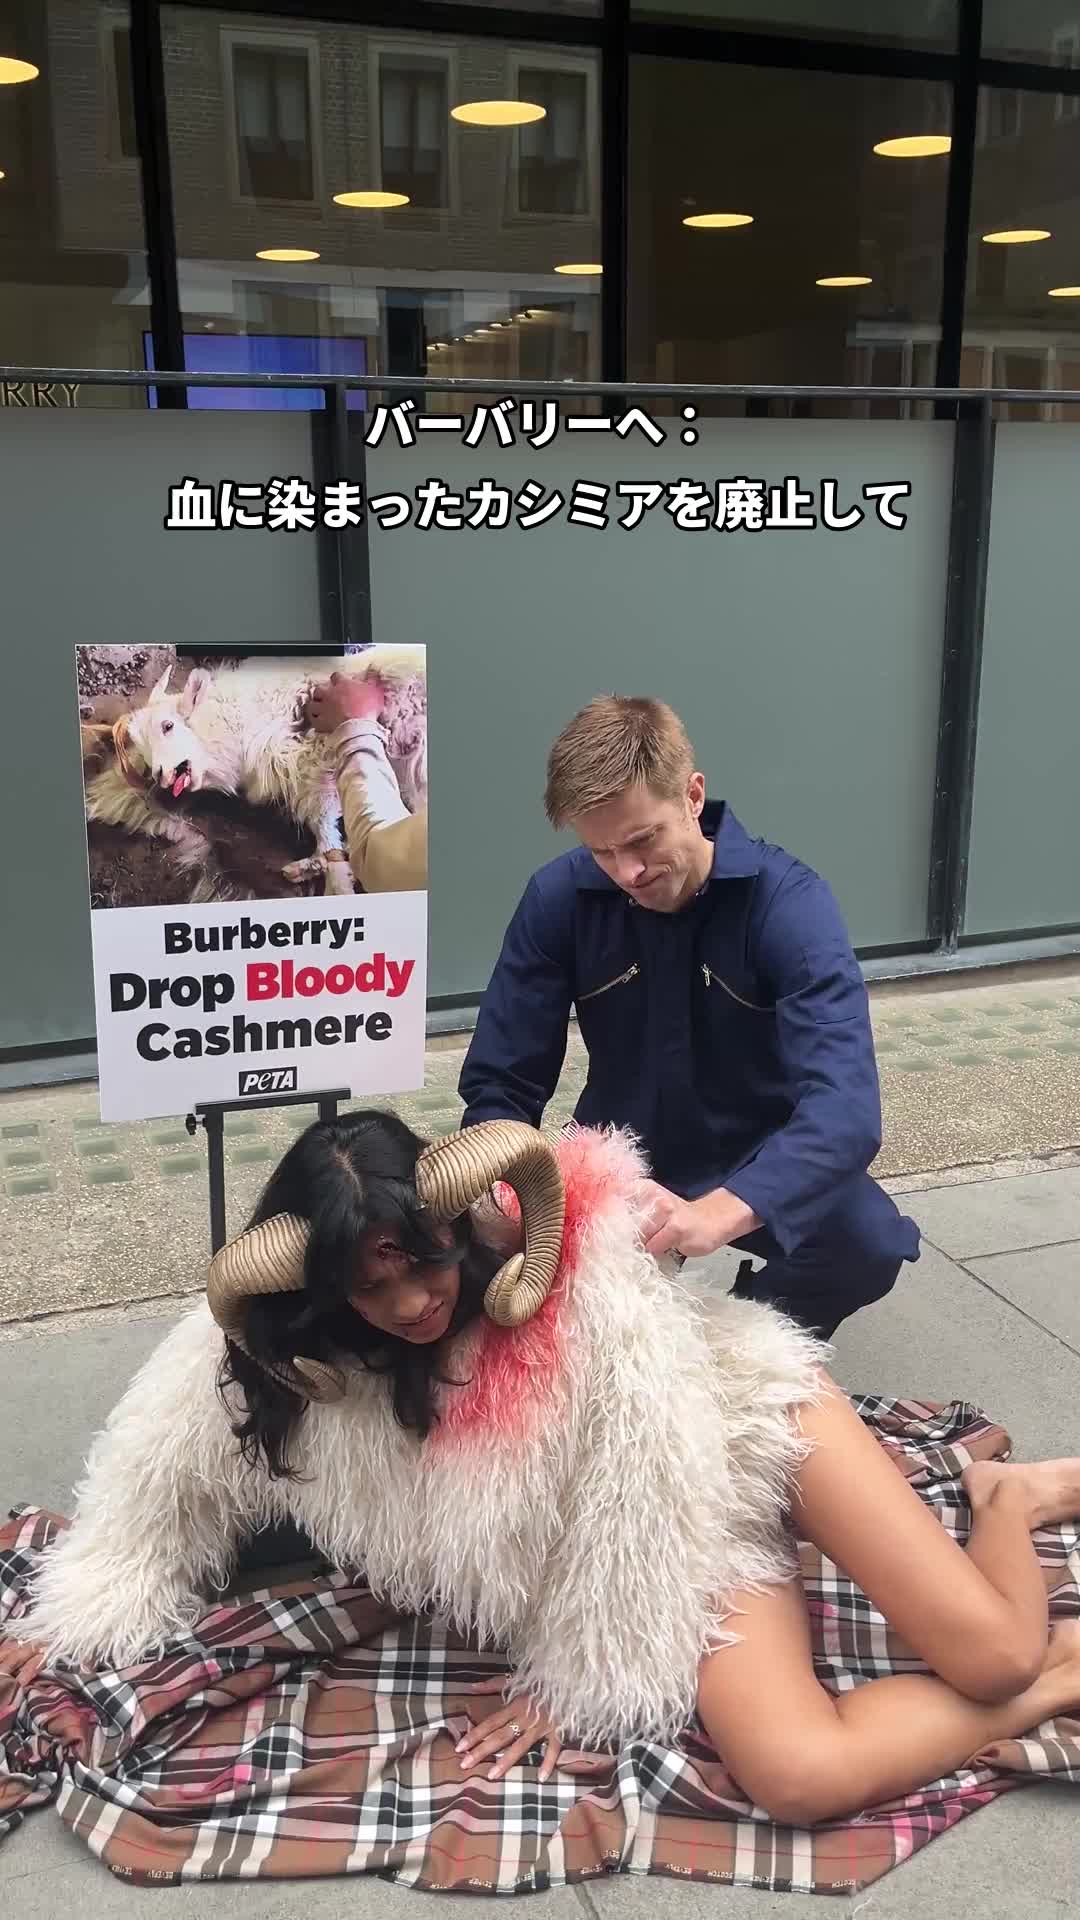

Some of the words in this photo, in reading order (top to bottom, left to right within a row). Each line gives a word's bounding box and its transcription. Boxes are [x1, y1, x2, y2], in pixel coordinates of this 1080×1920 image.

[164, 917, 364, 954] Burberry:
[109, 972, 235, 1013] Drop
[246, 952, 416, 1001] Bloody
[136, 1011, 393, 1062] Cashmere
